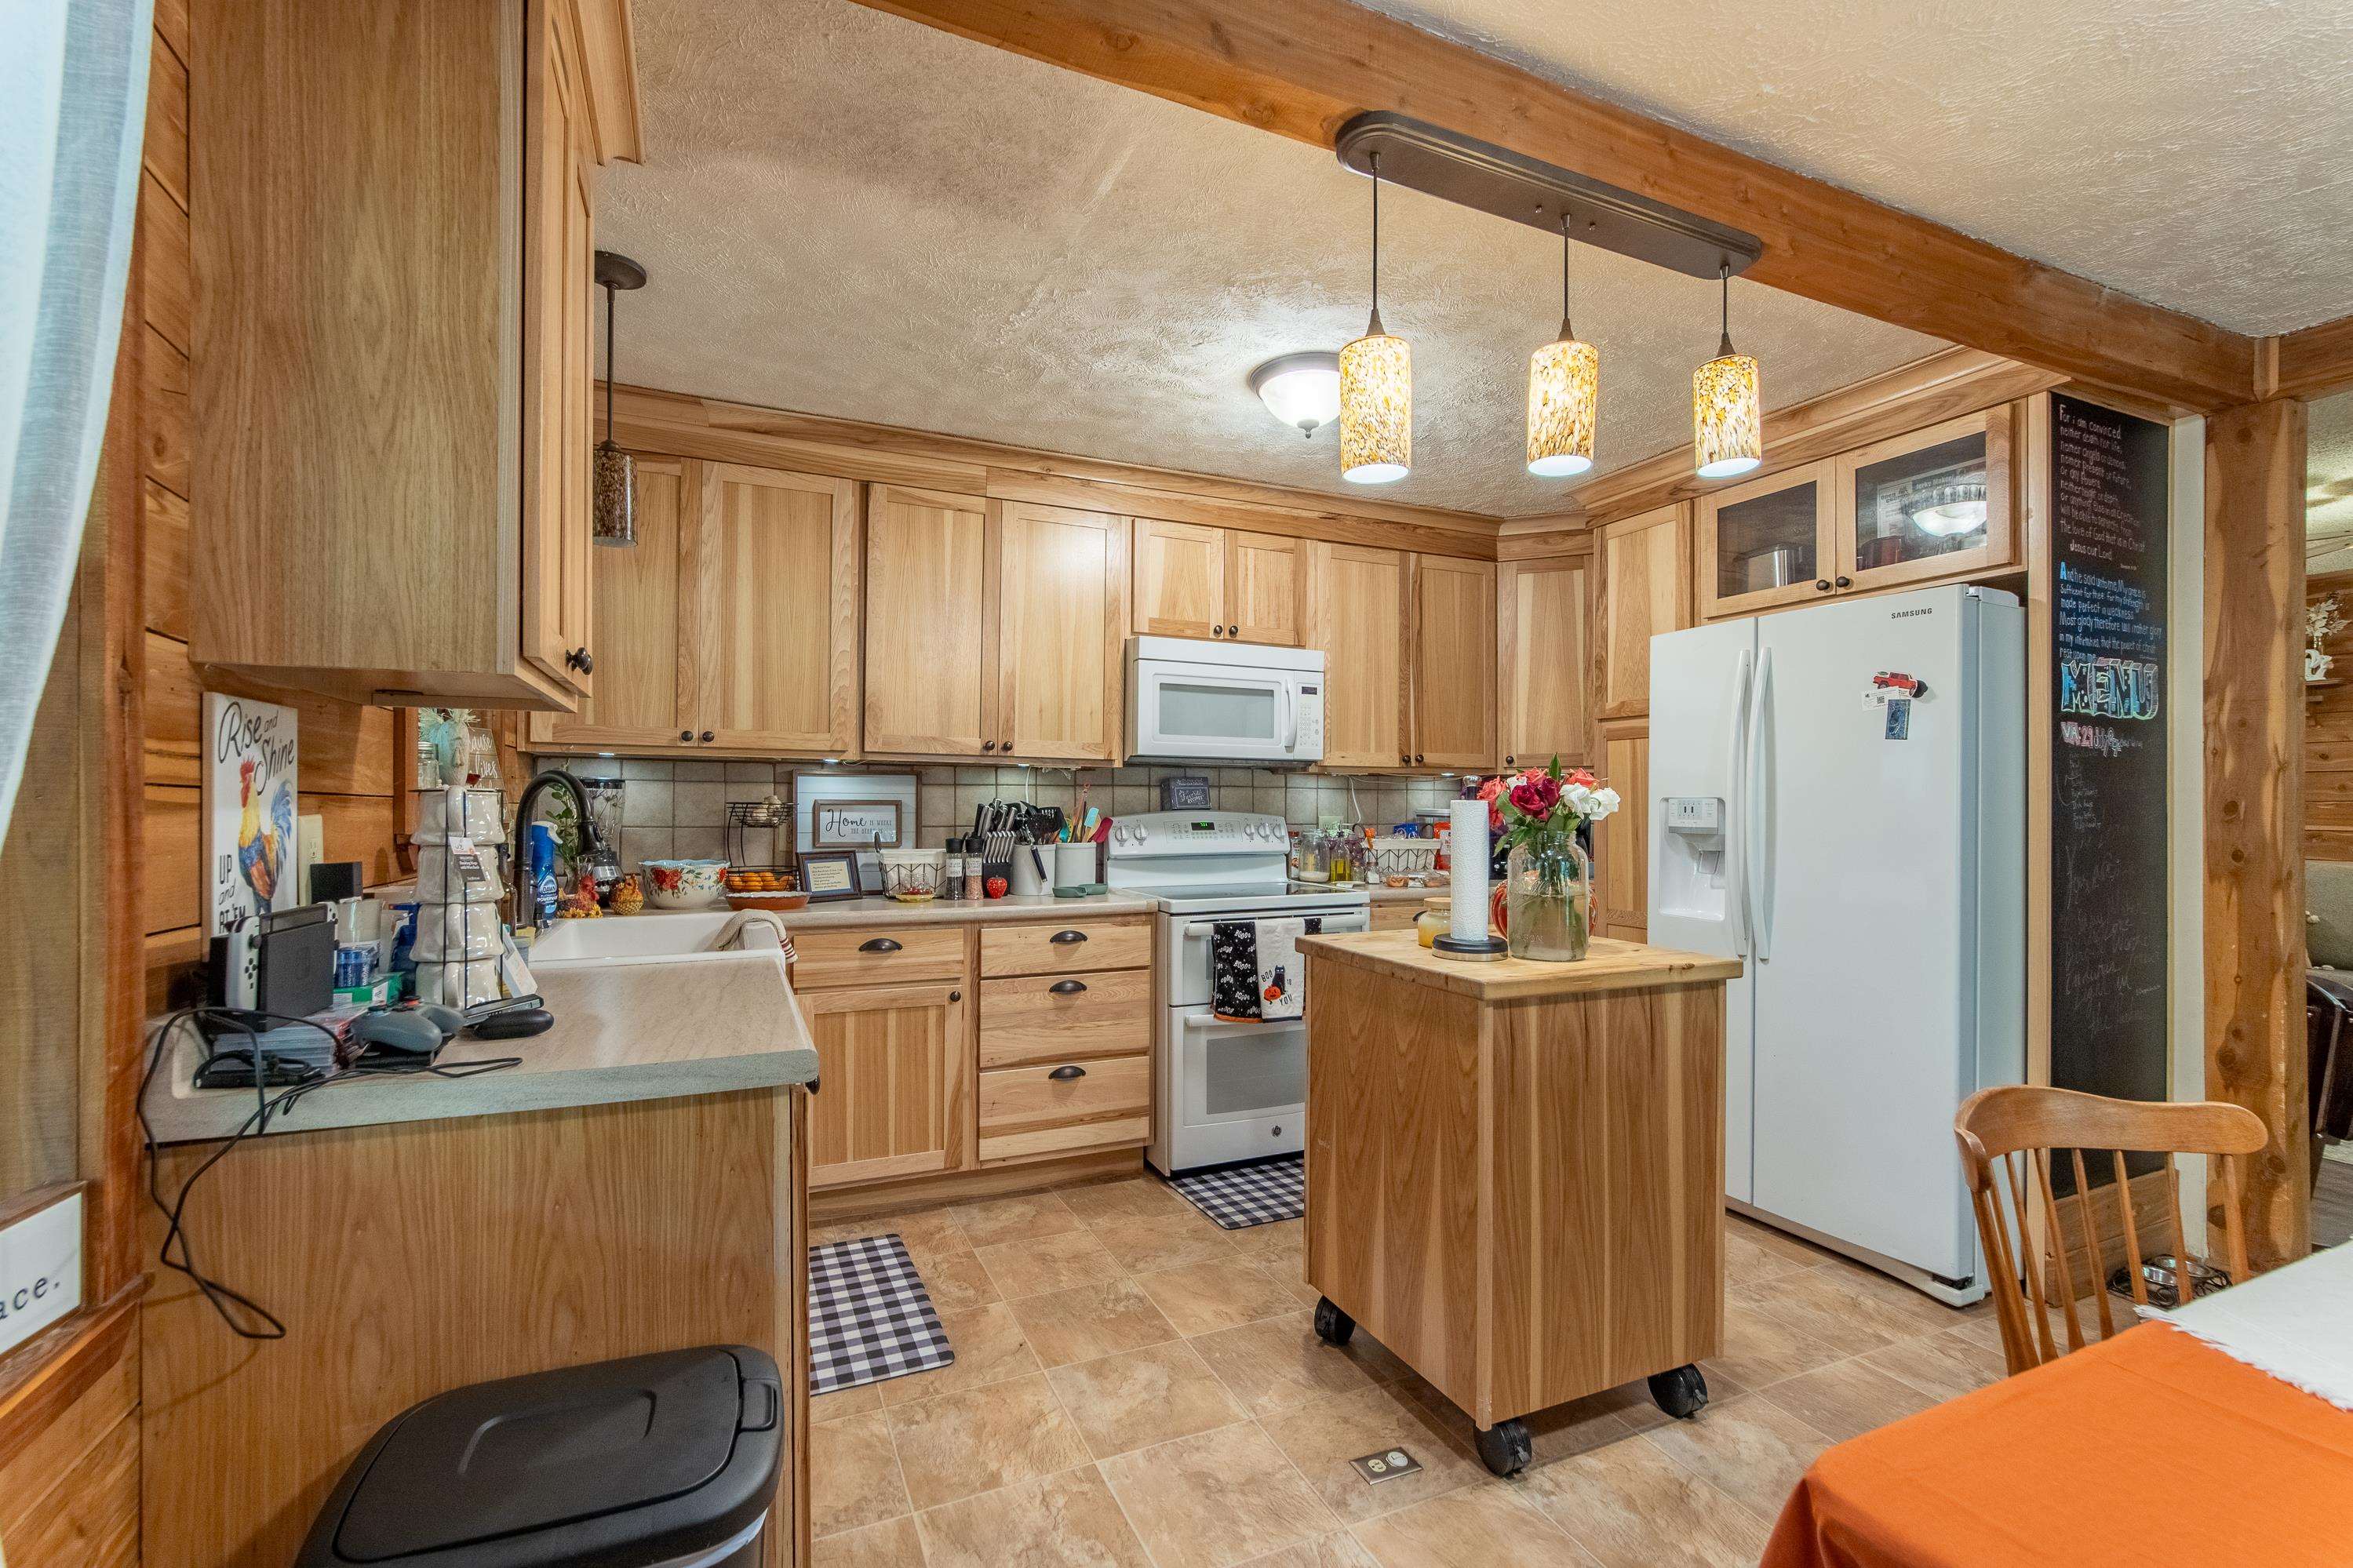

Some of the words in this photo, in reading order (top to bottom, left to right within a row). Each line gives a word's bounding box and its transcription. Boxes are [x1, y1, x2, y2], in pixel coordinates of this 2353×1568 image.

[2060, 403, 2069, 422] For
[1891, 607, 1932, 619] SAMSUNG
[2060, 610, 2076, 628] Most
[2061, 657, 2158, 720] MENU
[219, 701, 263, 764] Rise
[264, 711, 279, 733] and
[253, 737, 295, 795] Shine
[826, 809, 867, 837] Home
[220, 853, 233, 885] UP
[218, 879, 237, 905] and
[219, 909, 230, 934] AT
[1261, 970, 1273, 982] BOO
[1279, 994, 1293, 1006] YOU
